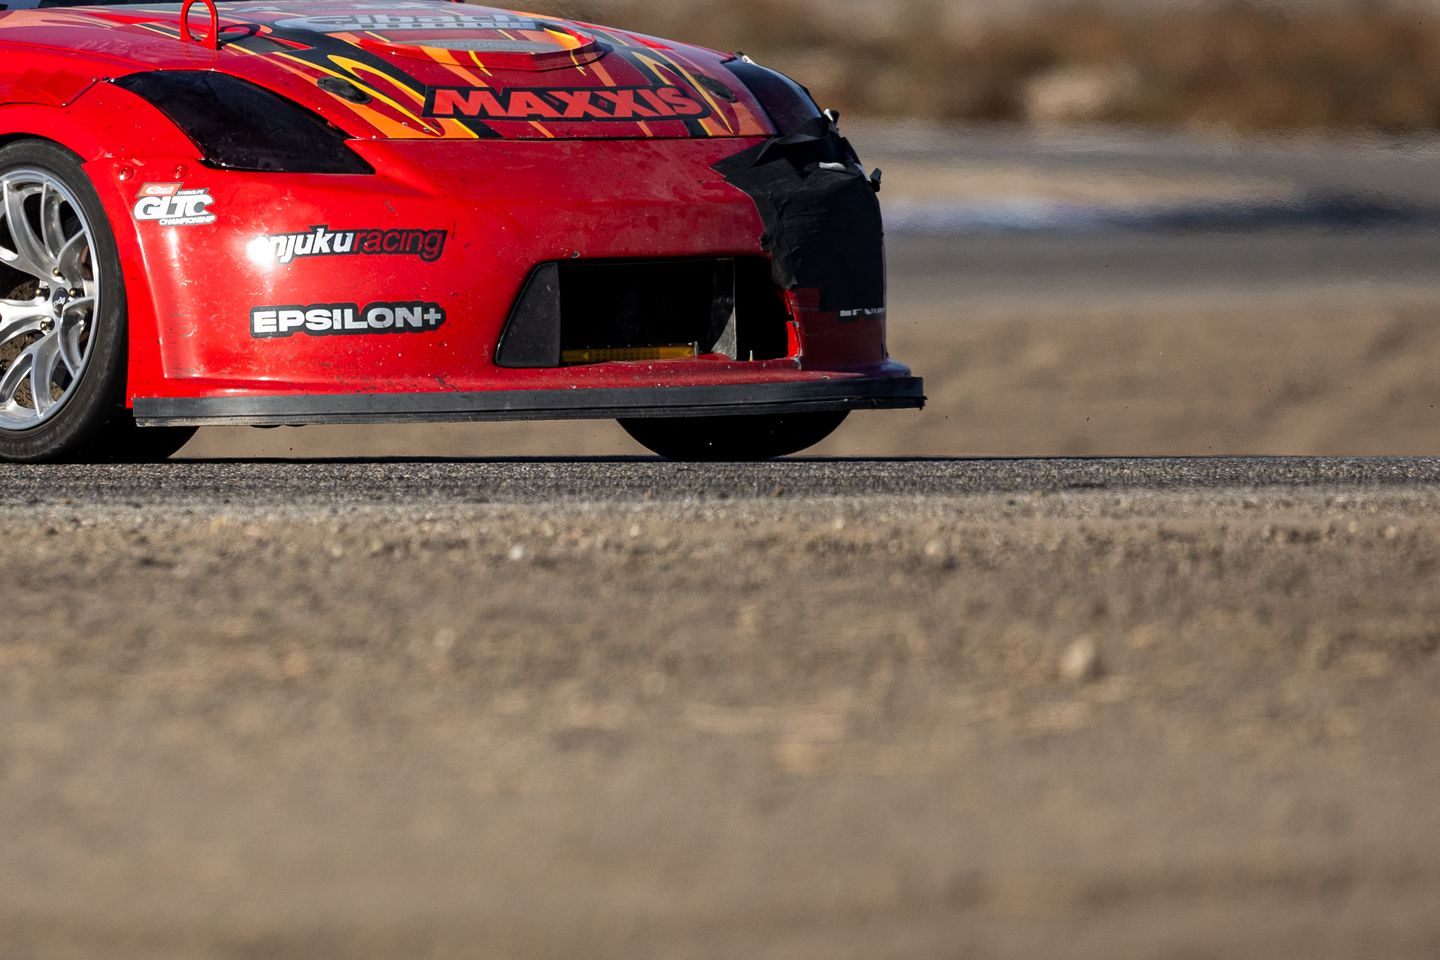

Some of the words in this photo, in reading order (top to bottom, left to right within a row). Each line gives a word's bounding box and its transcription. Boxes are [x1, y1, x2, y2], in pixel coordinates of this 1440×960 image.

[433, 87, 704, 118] MAXXIS
[134, 194, 214, 220] GLTC
[253, 306, 442, 333] EPSILON+
